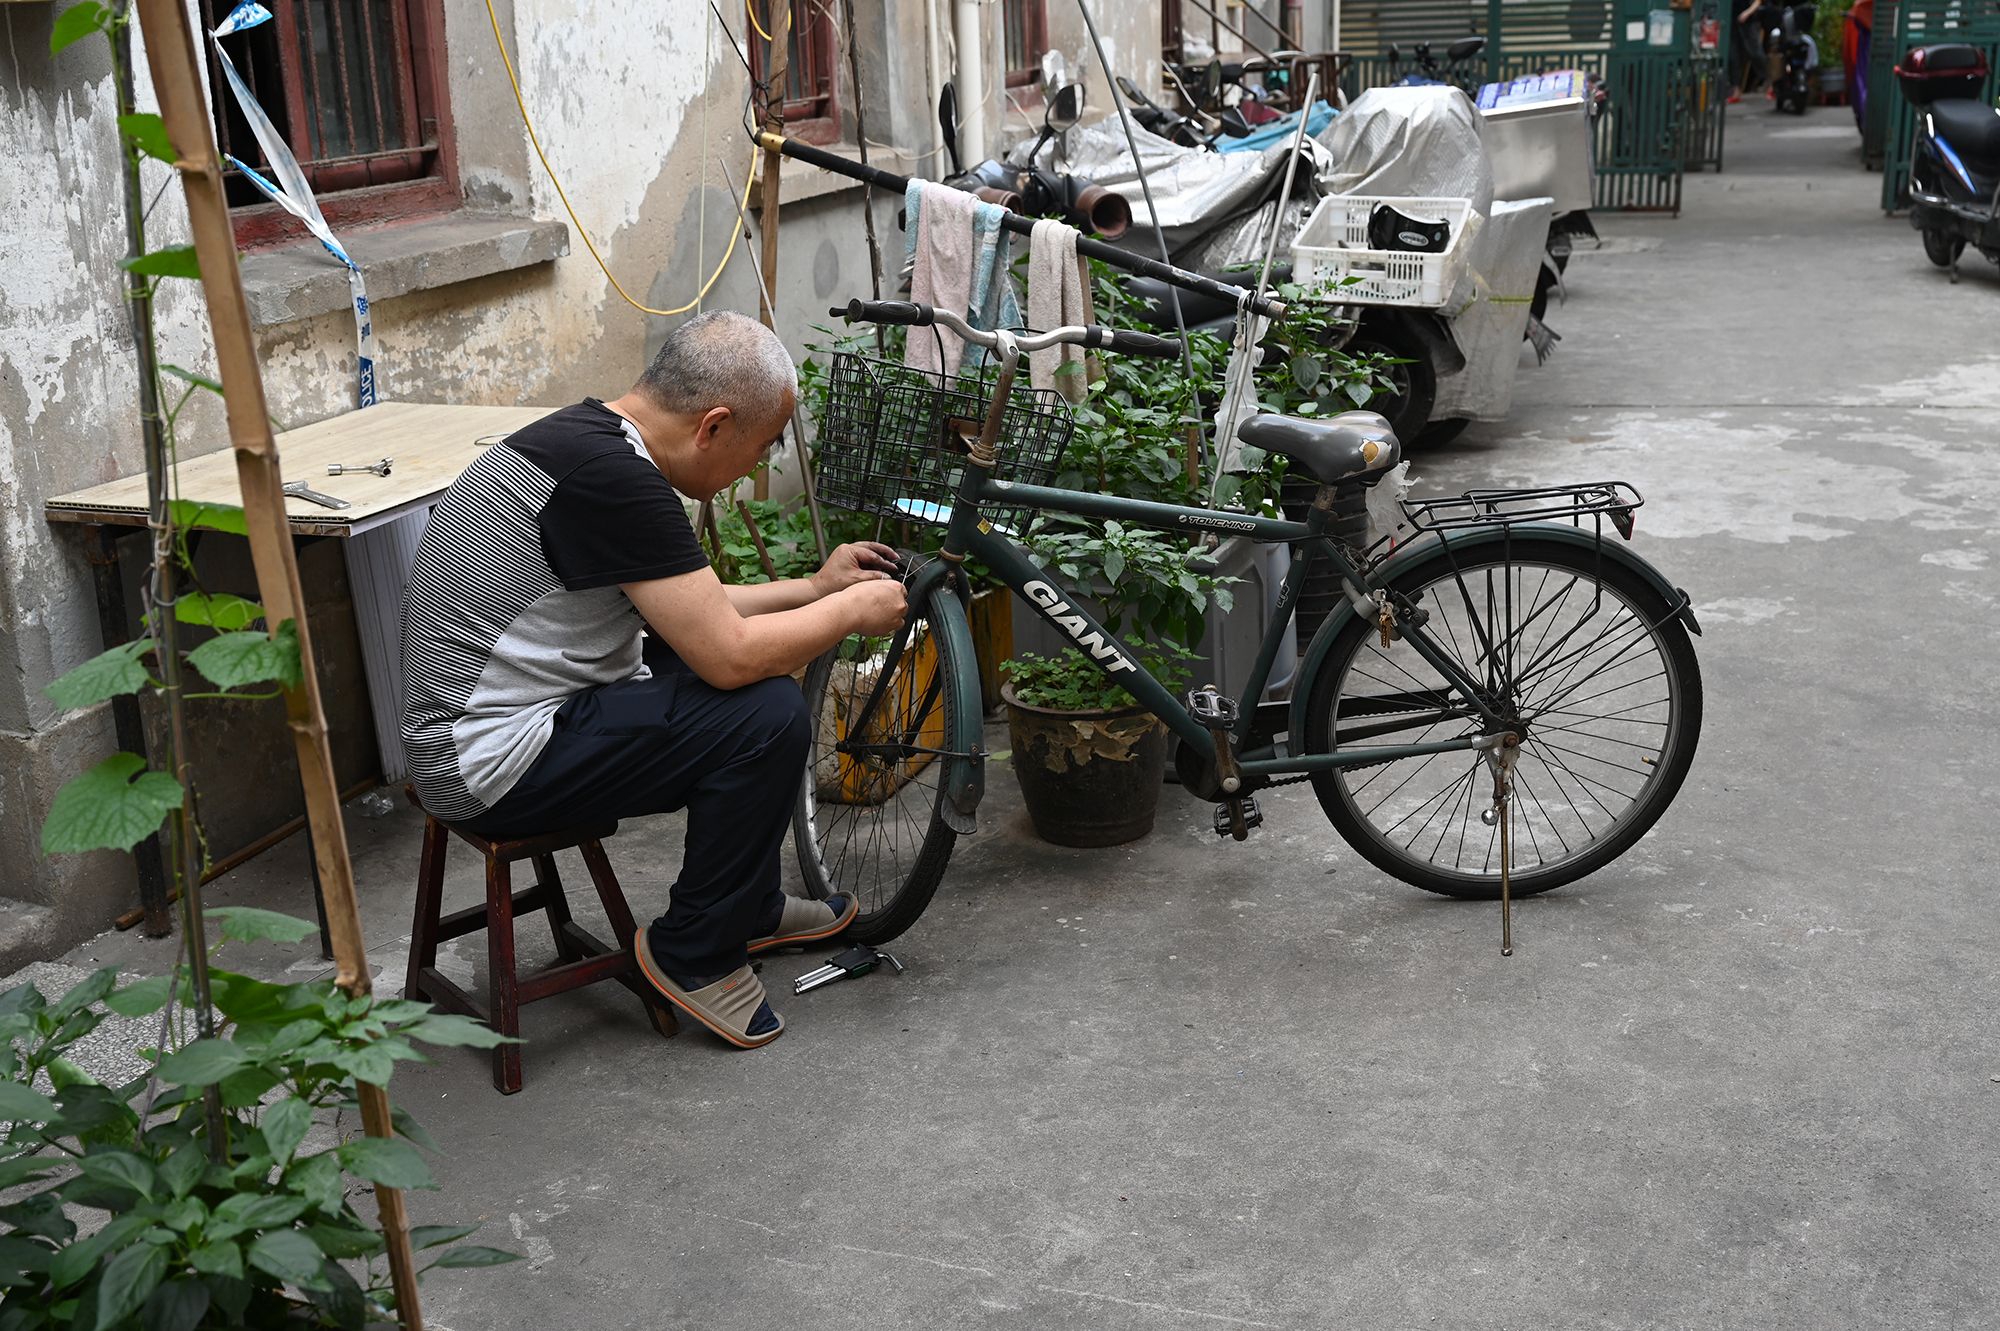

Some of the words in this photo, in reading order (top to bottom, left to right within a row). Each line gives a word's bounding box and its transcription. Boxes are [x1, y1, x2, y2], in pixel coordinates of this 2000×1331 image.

[361, 364, 372, 408] OLICE
[1188, 515, 1256, 531] TOUCHING
[1023, 580, 1137, 673] GIANT
